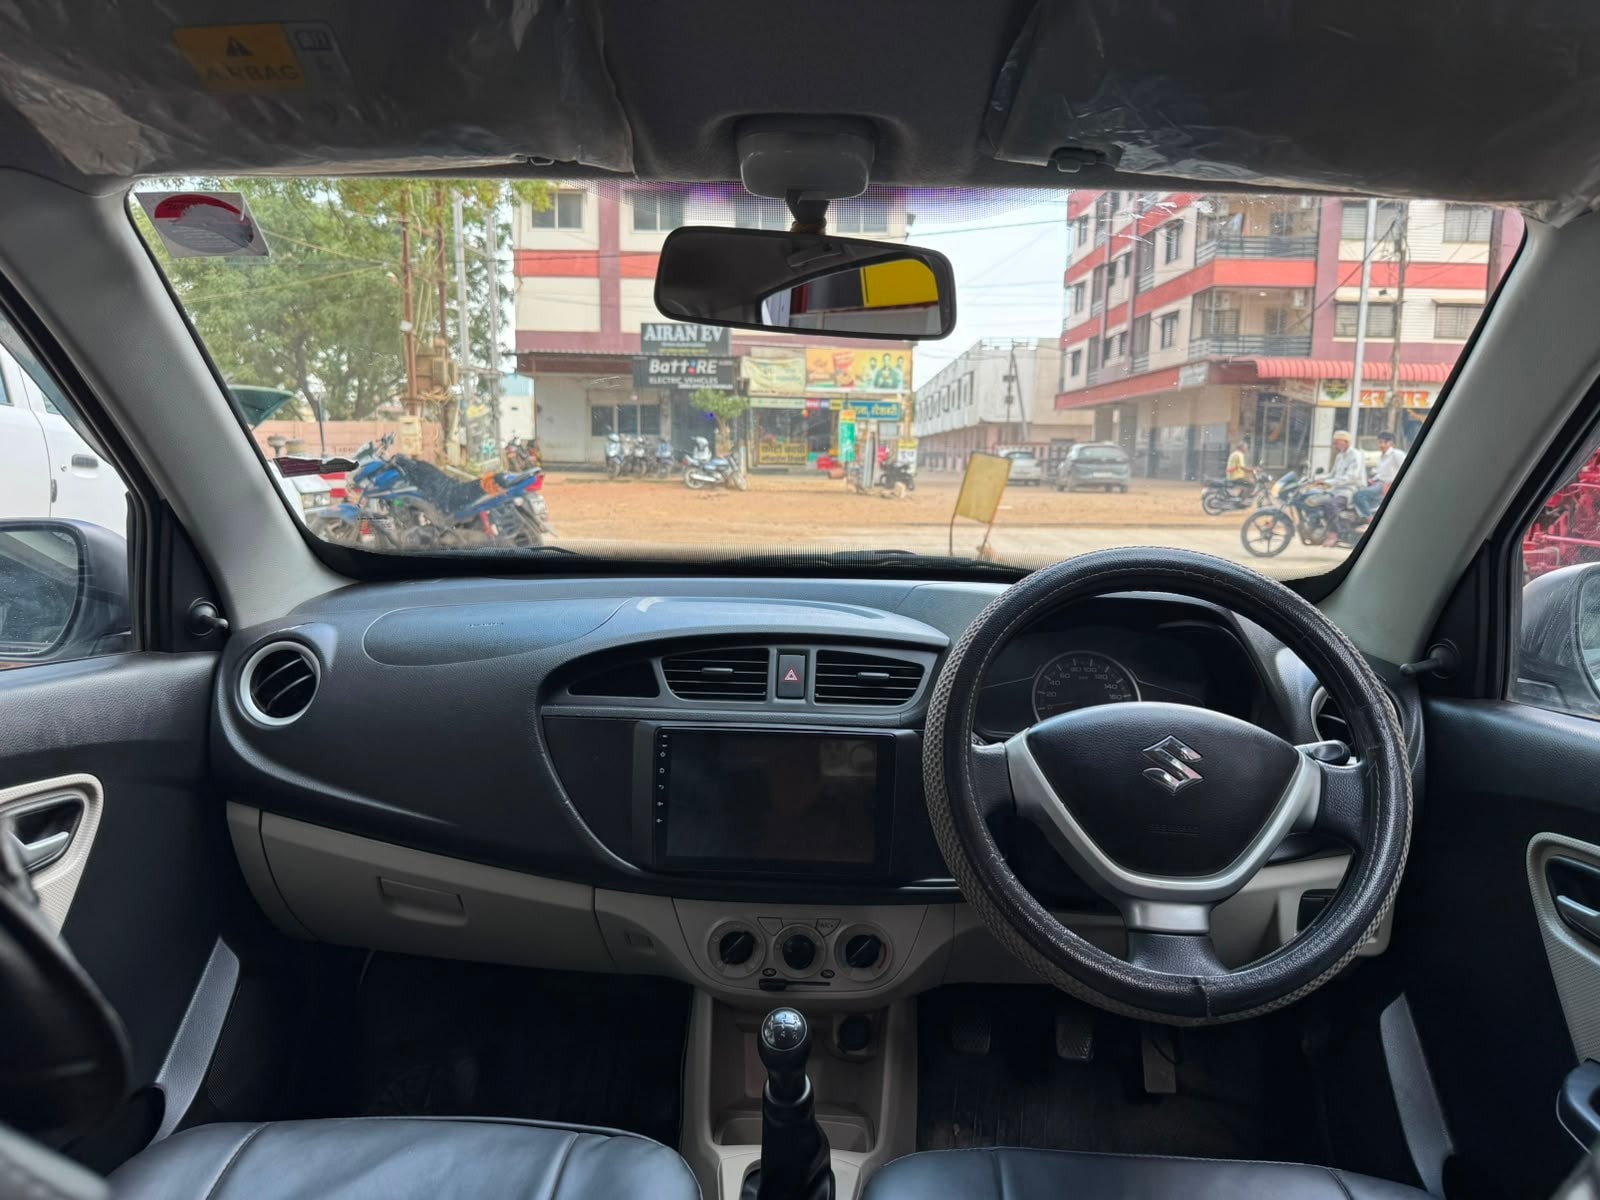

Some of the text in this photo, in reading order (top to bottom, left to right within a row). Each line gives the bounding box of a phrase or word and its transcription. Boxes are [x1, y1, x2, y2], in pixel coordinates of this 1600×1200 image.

[644, 324, 723, 342] AIRAN EV
[648, 376, 719, 385] ELECTRIC VEHICLES
